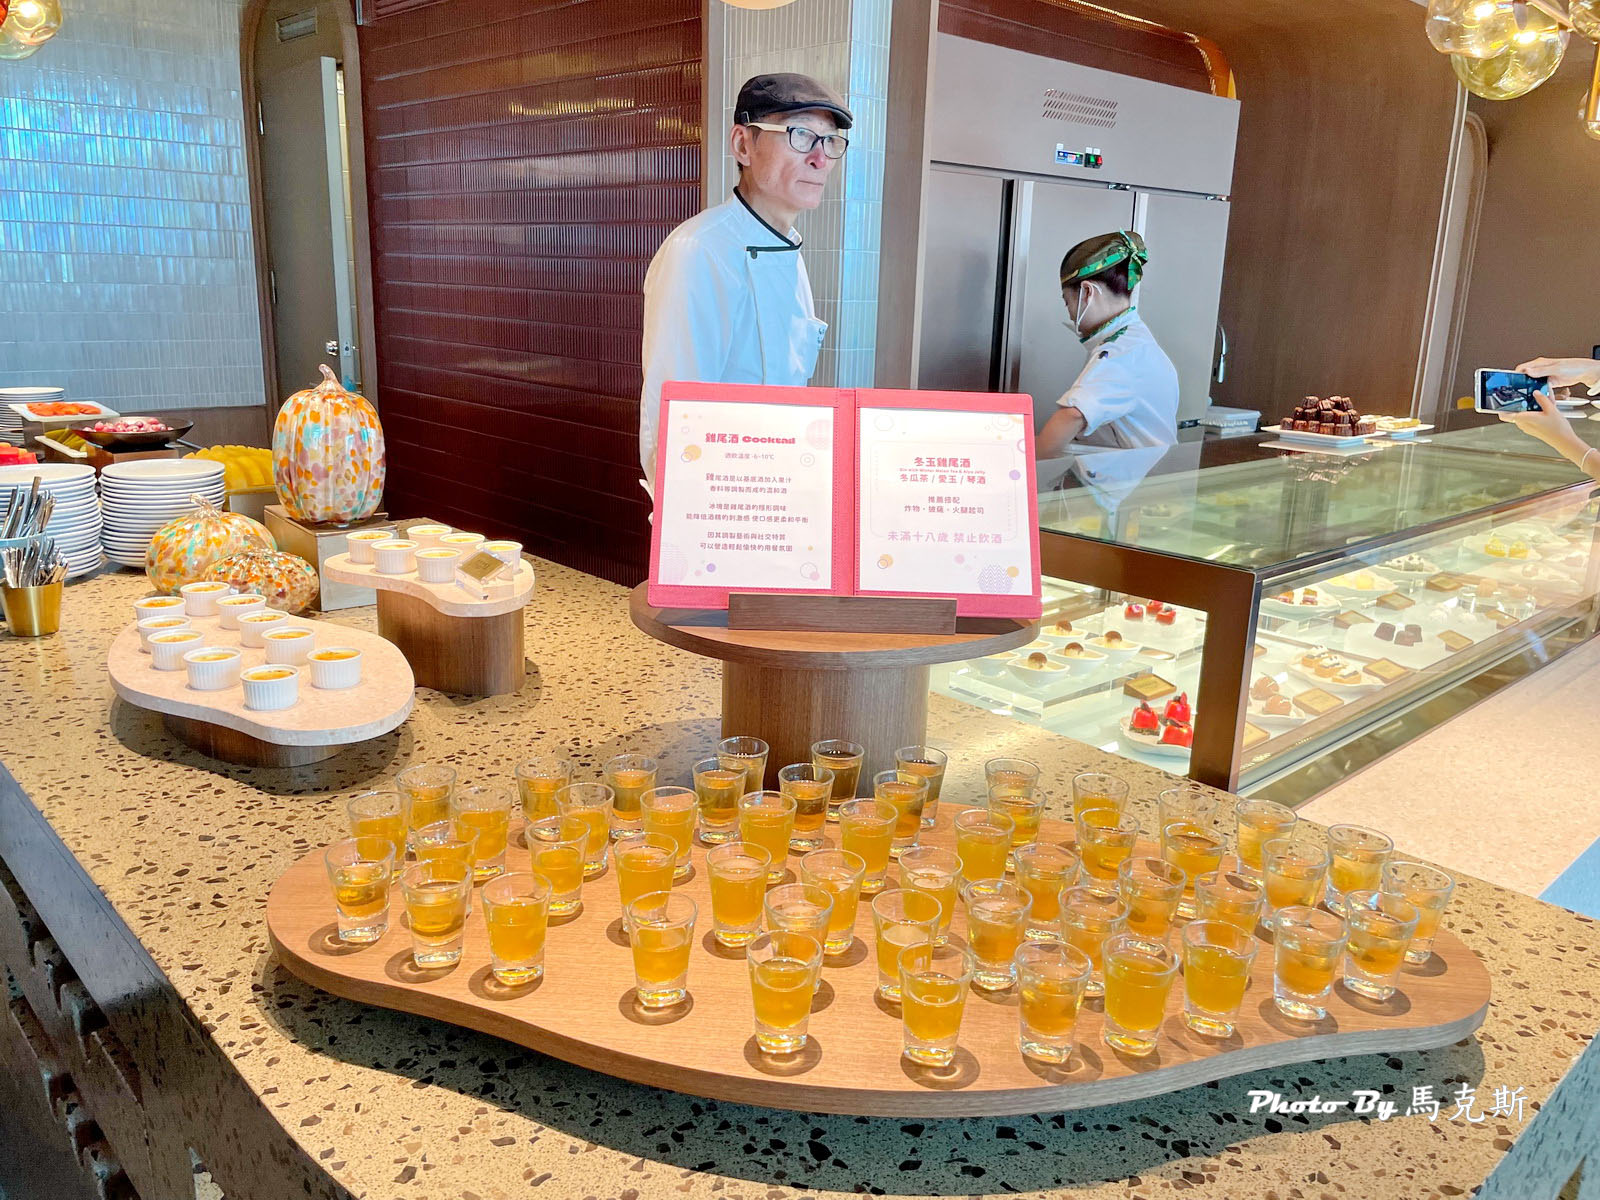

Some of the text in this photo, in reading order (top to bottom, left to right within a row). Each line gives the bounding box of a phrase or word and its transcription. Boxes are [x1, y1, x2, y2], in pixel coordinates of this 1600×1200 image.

[705, 433, 739, 443] 雞尾酒
[914, 457, 971, 468] 冬玉雞尾酒
[900, 474, 928, 482] 冬瓜茶
[938, 475, 957, 483] 愛玉
[967, 475, 986, 484] 琴酒
[888, 531, 1002, 543] 未滿十八歲 禁止飲酒
